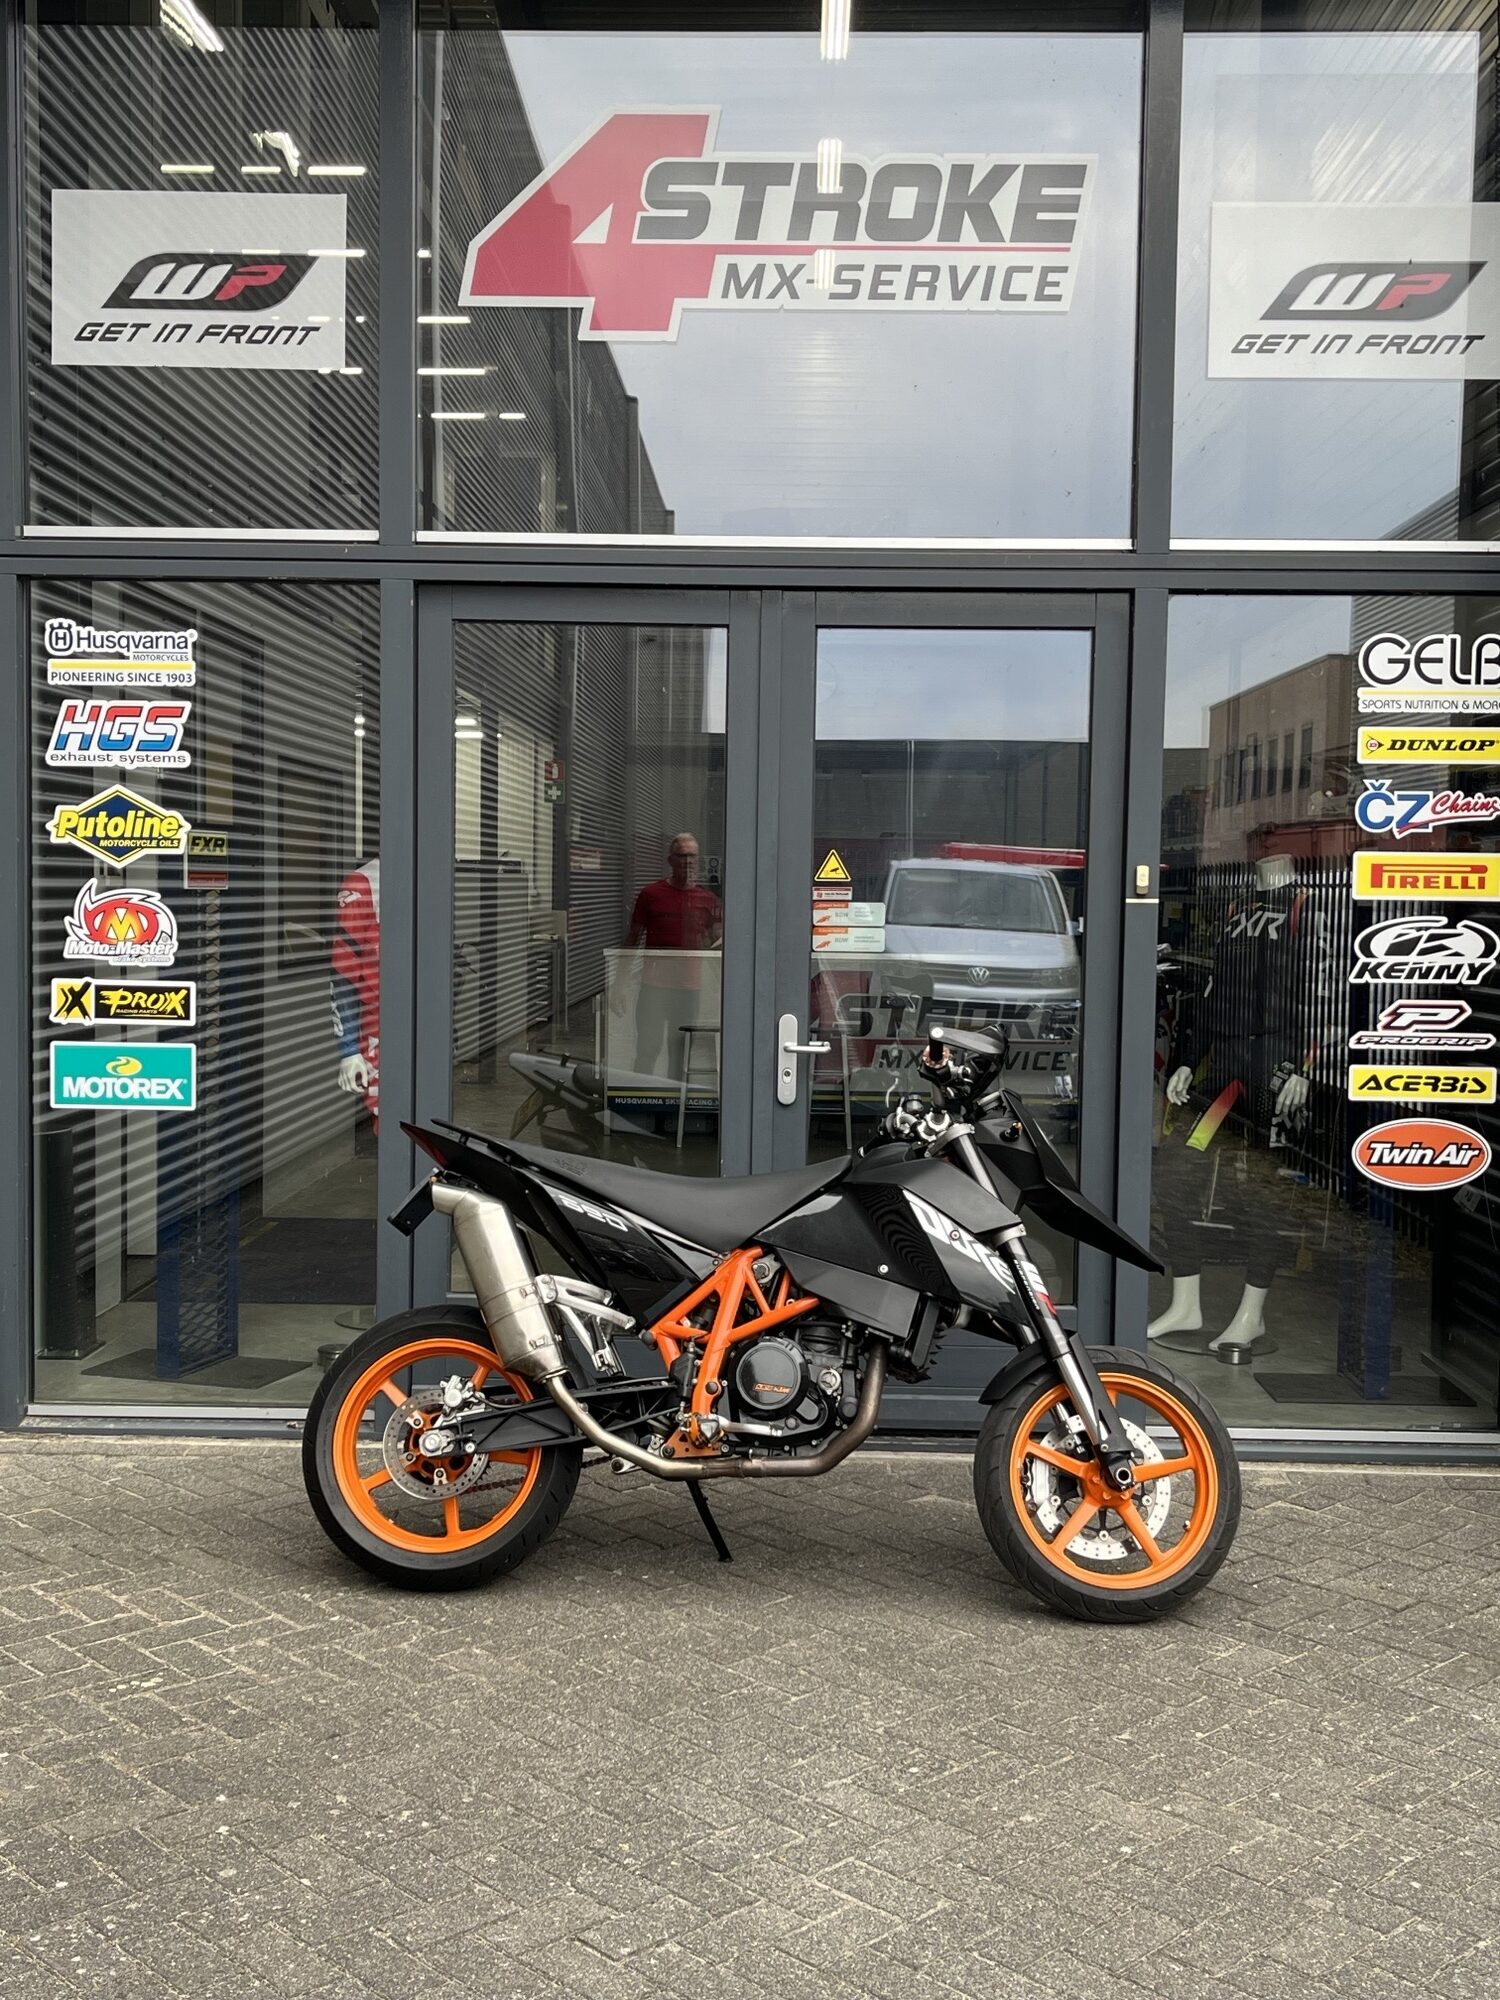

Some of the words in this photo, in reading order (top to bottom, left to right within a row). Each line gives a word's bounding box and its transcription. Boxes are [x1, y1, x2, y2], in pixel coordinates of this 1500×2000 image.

[469, 113, 711, 332] 4
[635, 160, 1089, 244] STROKE
[128, 261, 288, 301] WP
[720, 262, 1070, 303] MX-SERVICE
[1288, 272, 1452, 311] WP
[74, 322, 151, 343] GET
[152, 323, 193, 343] IN
[196, 324, 322, 346] FRONT
[1230, 334, 1310, 354] GET
[1310, 334, 1353, 354] IN
[1355, 335, 1486, 355] FRONT
[77, 630, 189, 652] Husqvarna
[133, 654, 189, 662] MOTORCYCLES
[51, 671, 124, 683] PIONEERING
[128, 672, 162, 683] SINCE
[166, 673, 193, 684] 1903
[1362, 699, 1402, 710] SPORTS
[1405, 699, 1459, 710] NUTRITION
[1461, 700, 1470, 710] &
[54, 705, 186, 752] HGS
[1387, 739, 1496, 752] DUNLOP
[50, 751, 113, 762] exhaust
[119, 753, 187, 764] systems
[1431, 794, 1500, 815] Chains
[56, 809, 180, 839] Putoline
[100, 838, 157, 848] MOTORCYCLE
[159, 839, 180, 848] OILS
[1370, 863, 1488, 889] PIRELLI
[1353, 961, 1493, 981] KENNY
[1358, 1035, 1489, 1046] PROGRIP
[62, 1076, 184, 1100] MOTOREX
[1358, 1074, 1487, 1094] ACERBIS
[615, 1097, 663, 1105] HUSQVARNA
[1367, 1142, 1434, 1167] Twin
[1433, 1143, 1481, 1168] Air
